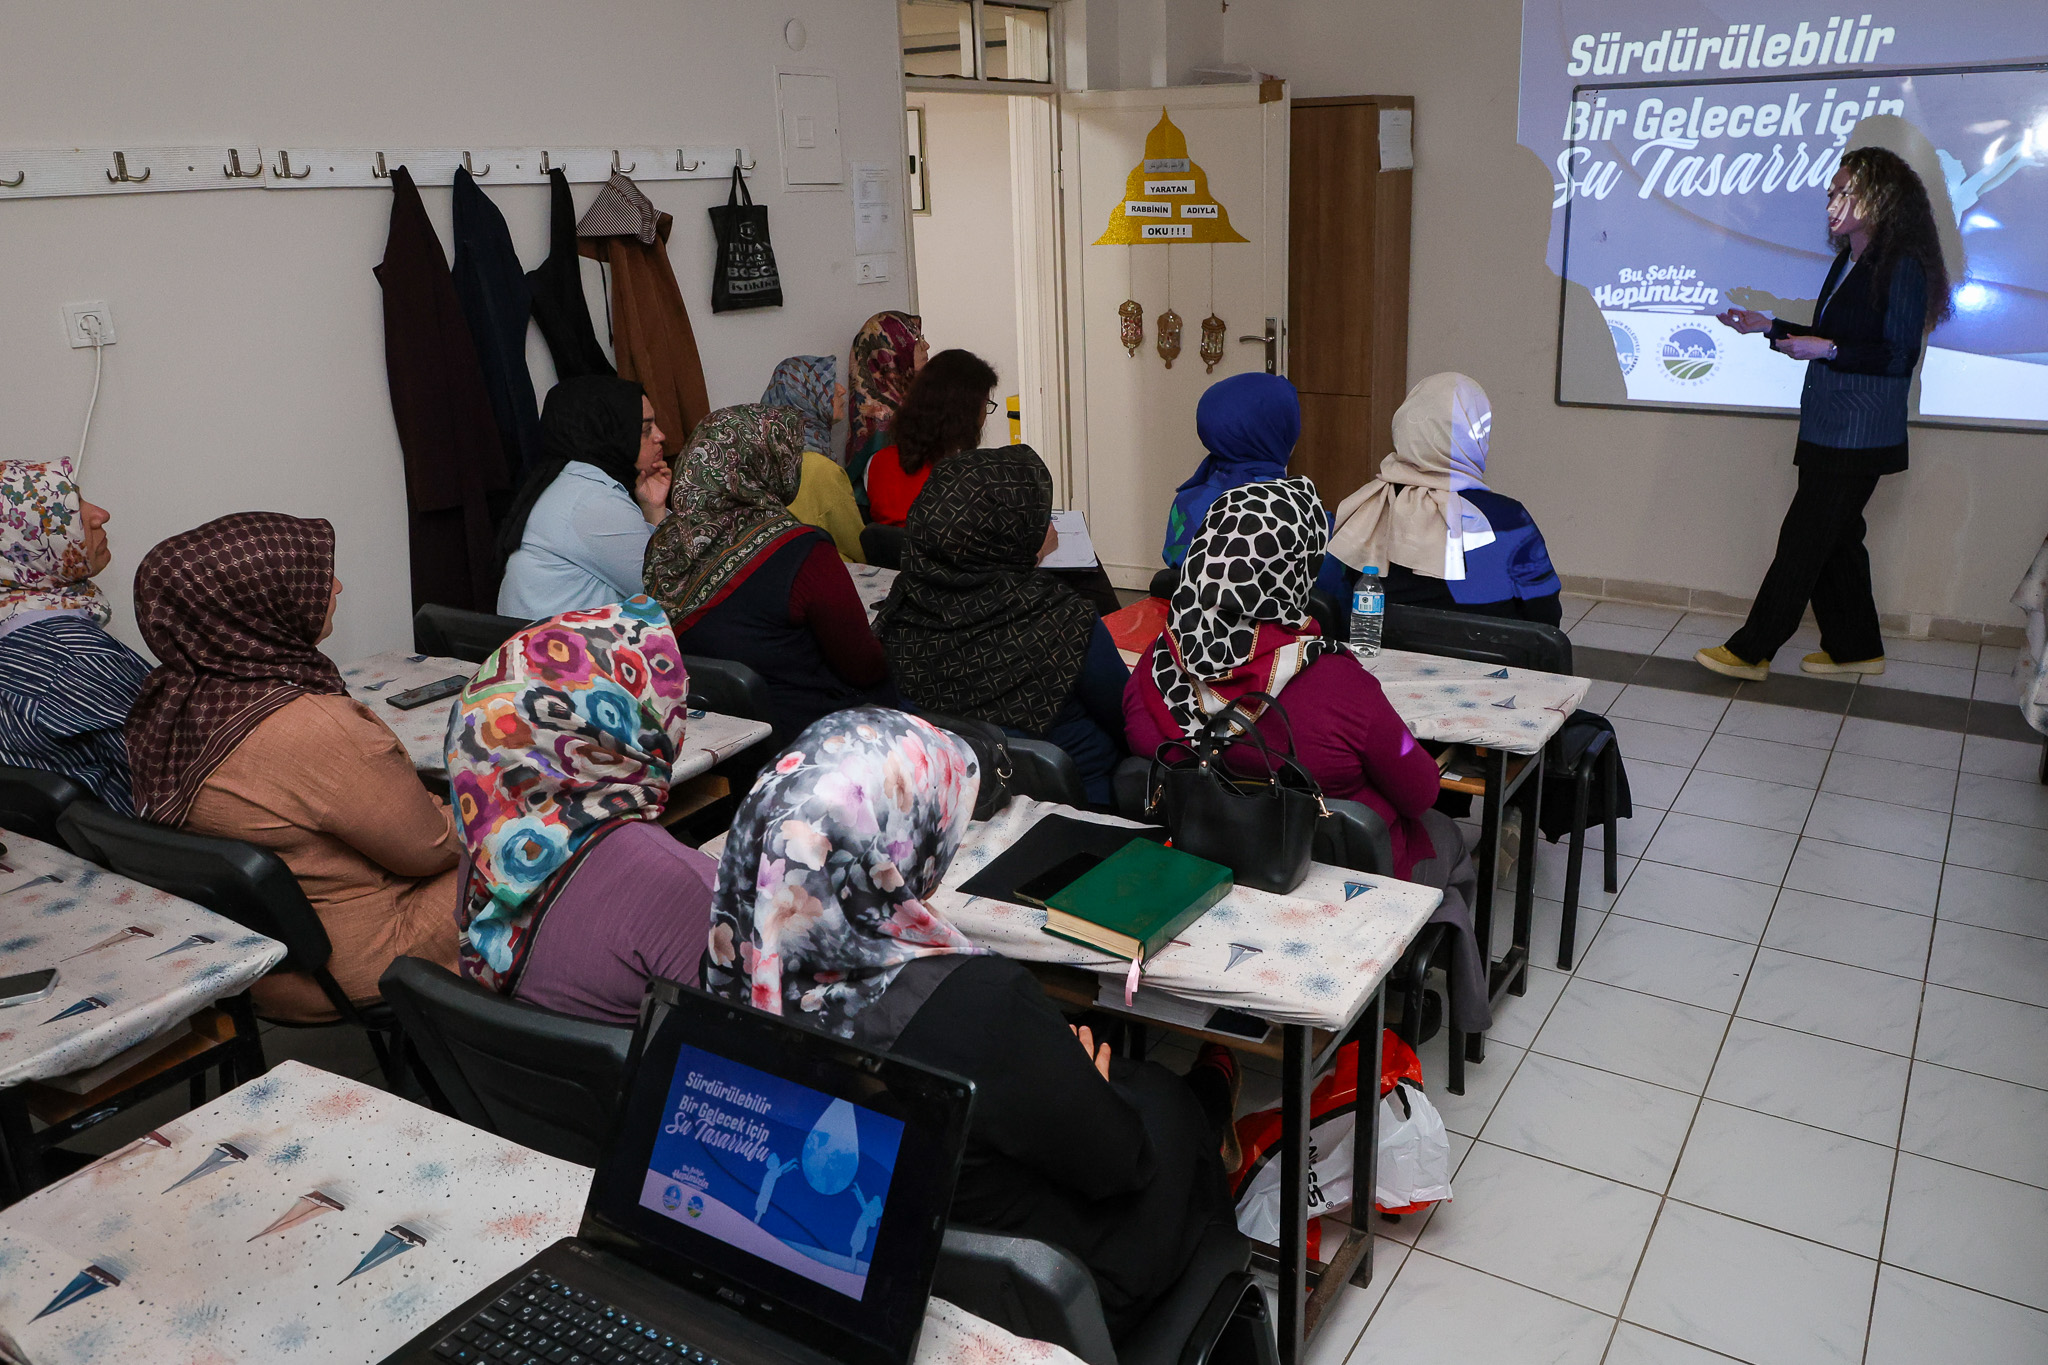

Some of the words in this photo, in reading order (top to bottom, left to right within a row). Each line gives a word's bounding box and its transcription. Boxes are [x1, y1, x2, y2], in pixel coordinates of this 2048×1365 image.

[1567, 14, 1895, 77] Sürdürülebilir
[1563, 97, 1628, 141] Bir
[1632, 93, 1812, 141] Gelecek
[1815, 86, 1904, 147] için
[1553, 146, 1624, 209] Su
[1631, 137, 1845, 200] Tasarru
[1131, 205, 1169, 214] RABBİNİN
[1593, 280, 1719, 309] Hepimizin
[1618, 268, 1643, 284] Bu
[1645, 265, 1696, 285] Şehir
[1670, 322, 1713, 334] SAKARYA
[685, 1071, 772, 1115] Sürdürülebilir
[665, 1112, 693, 1135] Su
[694, 1118, 770, 1162] Tasarrufu
[679, 1095, 698, 1113] Bir
[698, 1102, 747, 1133] Gelecek
[745, 1119, 770, 1142] için
